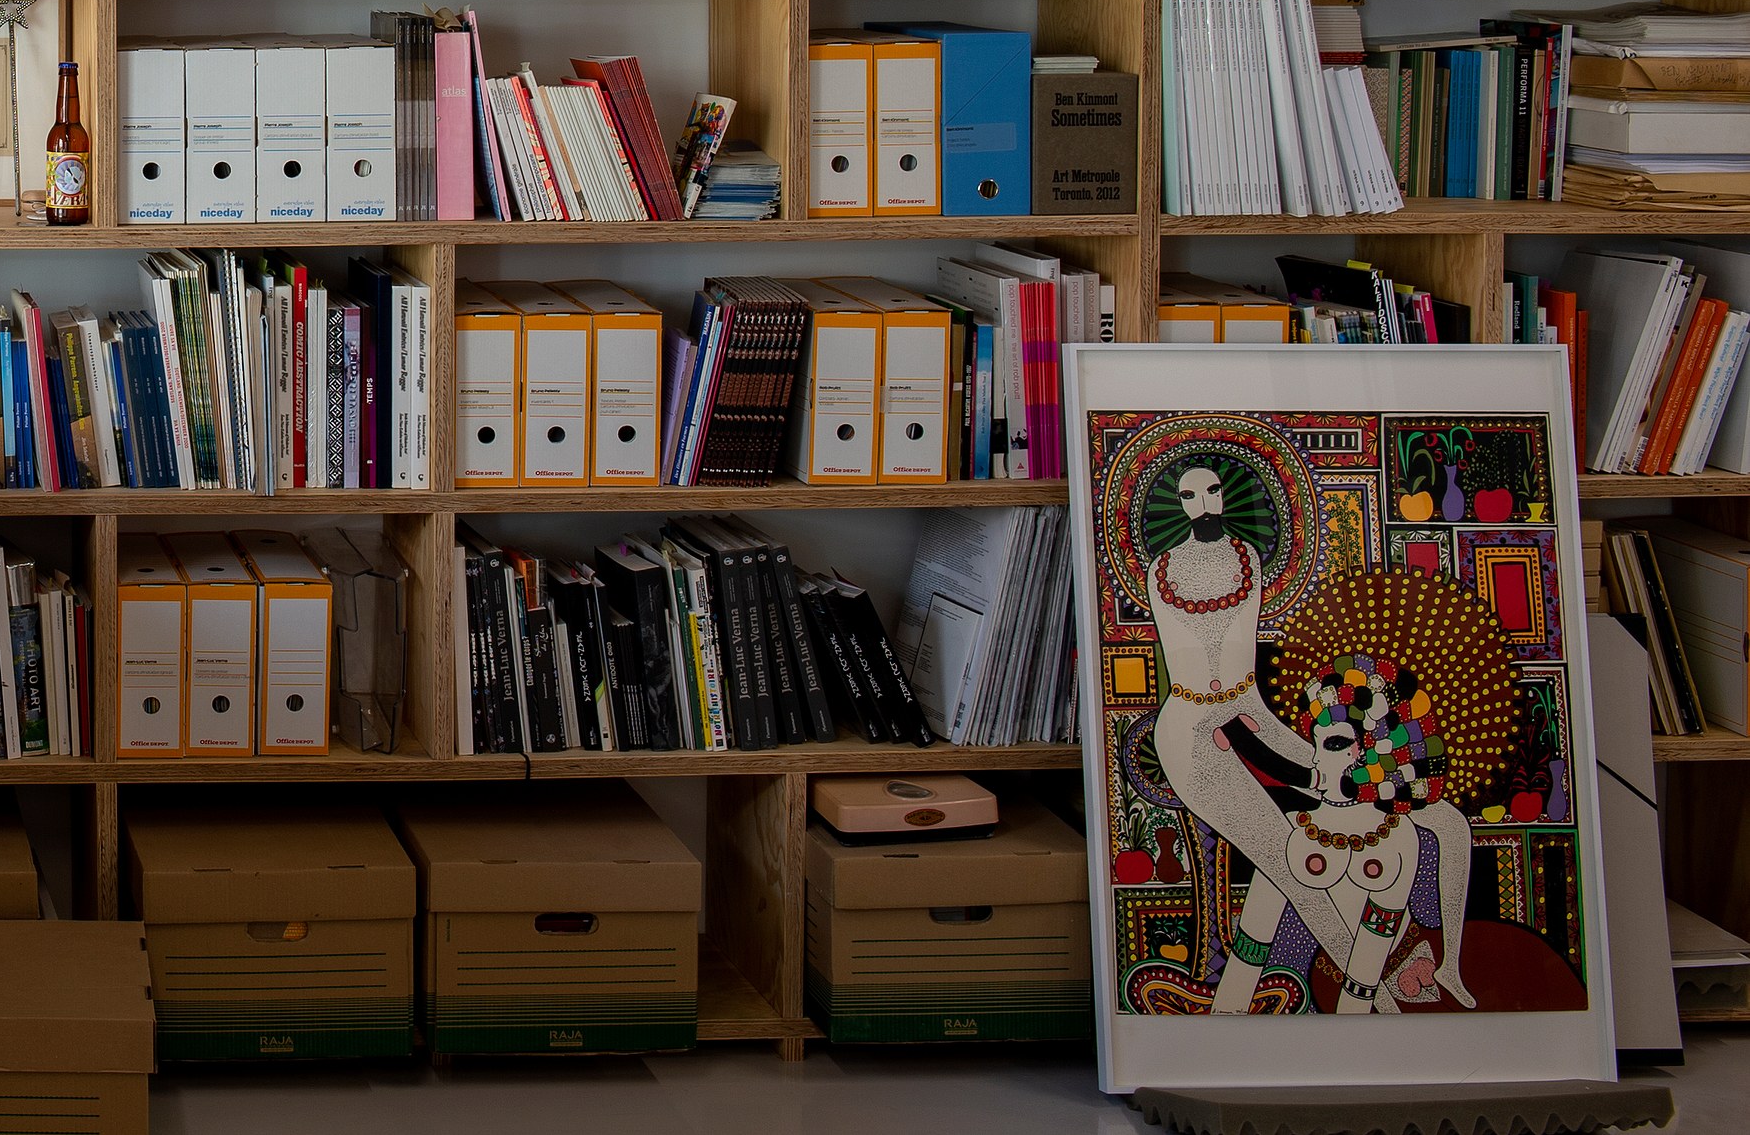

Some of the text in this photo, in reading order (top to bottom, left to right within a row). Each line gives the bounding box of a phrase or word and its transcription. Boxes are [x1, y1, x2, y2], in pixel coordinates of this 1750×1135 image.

[1519, 58, 1530, 103] PERFORMA
[442, 85, 467, 97] atlas
[1055, 92, 1118, 105] Ben Kinmont
[1052, 109, 1122, 127] Sometimes
[1052, 169, 1120, 185] Art Metropole
[1096, 186, 1120, 200] 2012
[129, 208, 173, 219] niceday
[341, 206, 384, 217] niceday
[295, 322, 304, 433] COMIC ABSTRACTION
[497, 610, 515, 702] Jean-Luc Verna
[26, 640, 41, 713] PHOTO ART
[944, 1018, 977, 1028] RAJA
[259, 1036, 293, 1046] RAJA
[550, 1030, 582, 1040] RAJA
